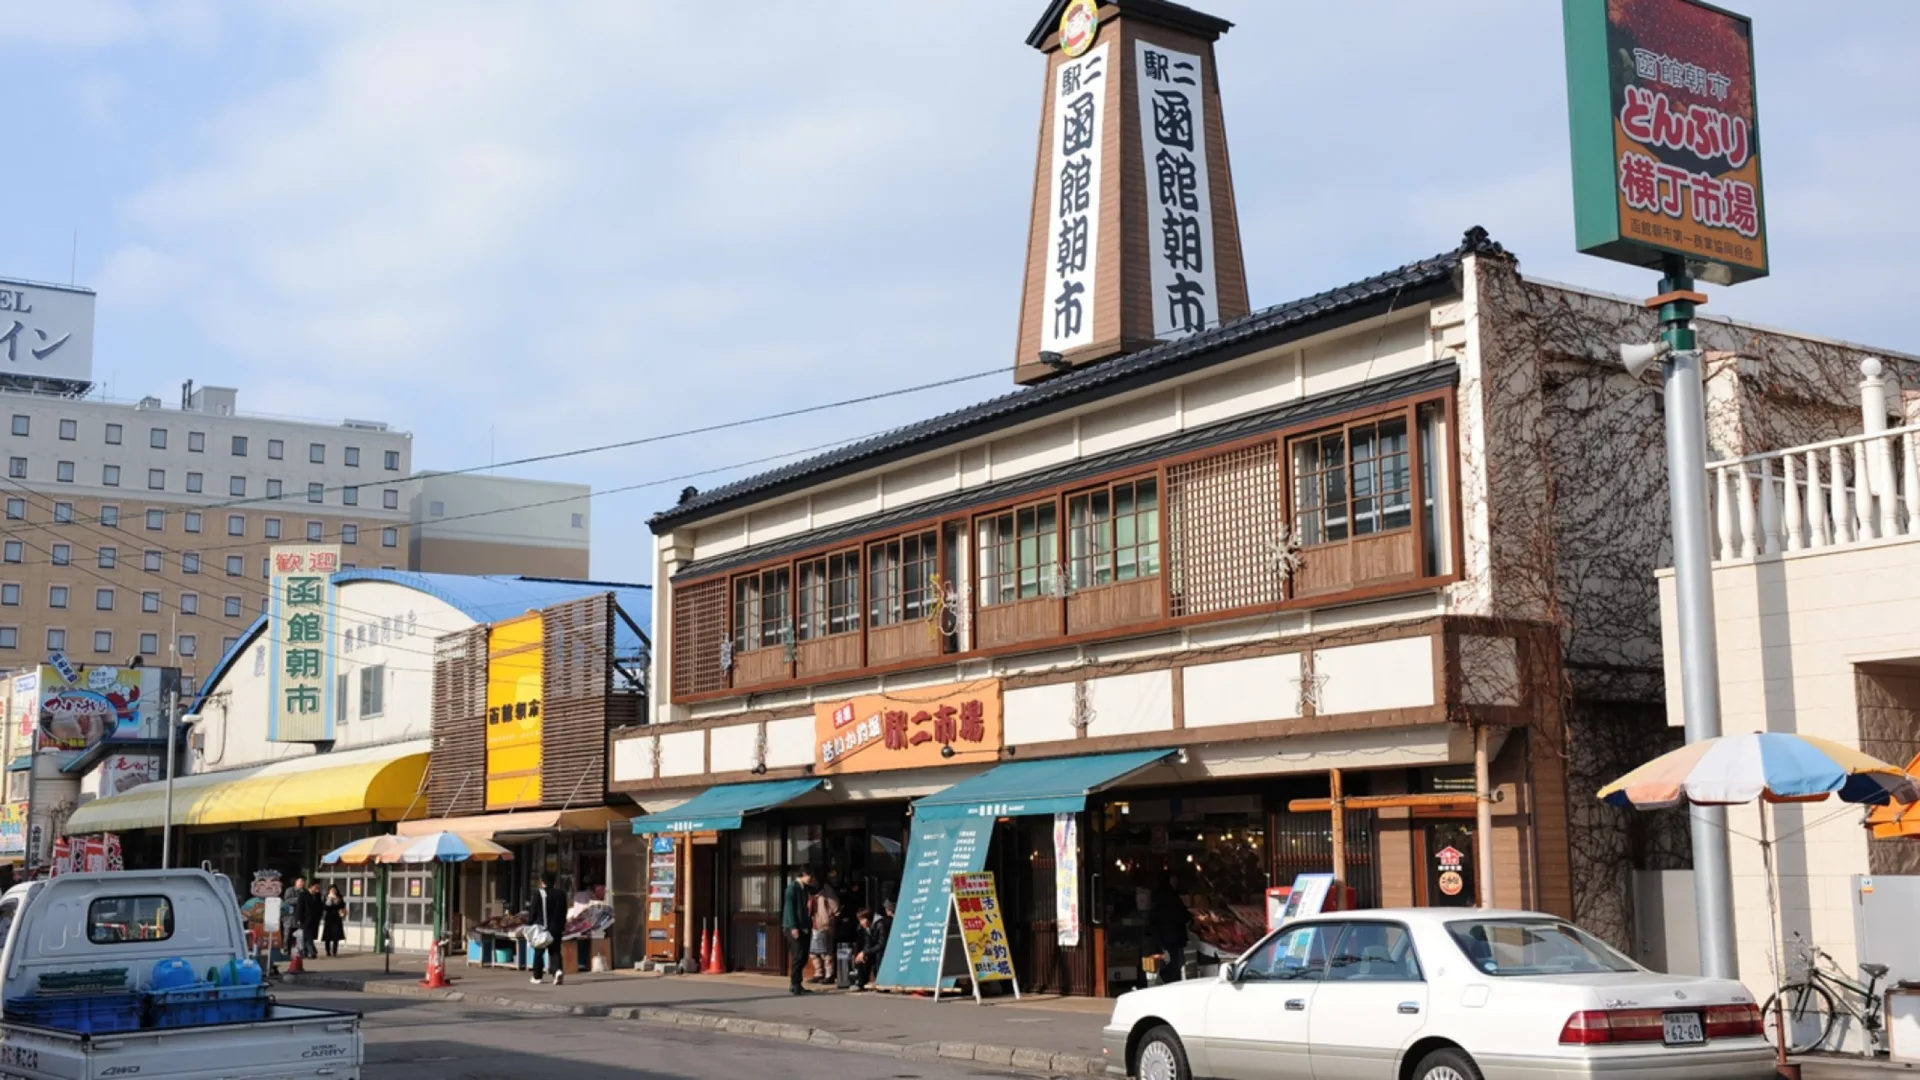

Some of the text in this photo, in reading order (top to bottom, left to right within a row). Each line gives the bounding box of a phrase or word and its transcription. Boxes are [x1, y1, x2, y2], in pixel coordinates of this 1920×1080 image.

[1633, 48, 1730, 101] 函館朝市
[1620, 85, 1748, 168] どんぶり
[1054, 91, 1094, 339] 函館朝市
[1151, 89, 1205, 333] 函館朝市
[1619, 152, 1758, 237] 横丁市場
[275, 552, 337, 572] 歓迎
[285, 576, 323, 714] 函館朝市
[489, 699, 541, 725] 函館朝市
[884, 699, 985, 751] 駅二市場
[301, 1047, 347, 1058] CARRY
[1671, 1024, 1701, 1041] 62-60
